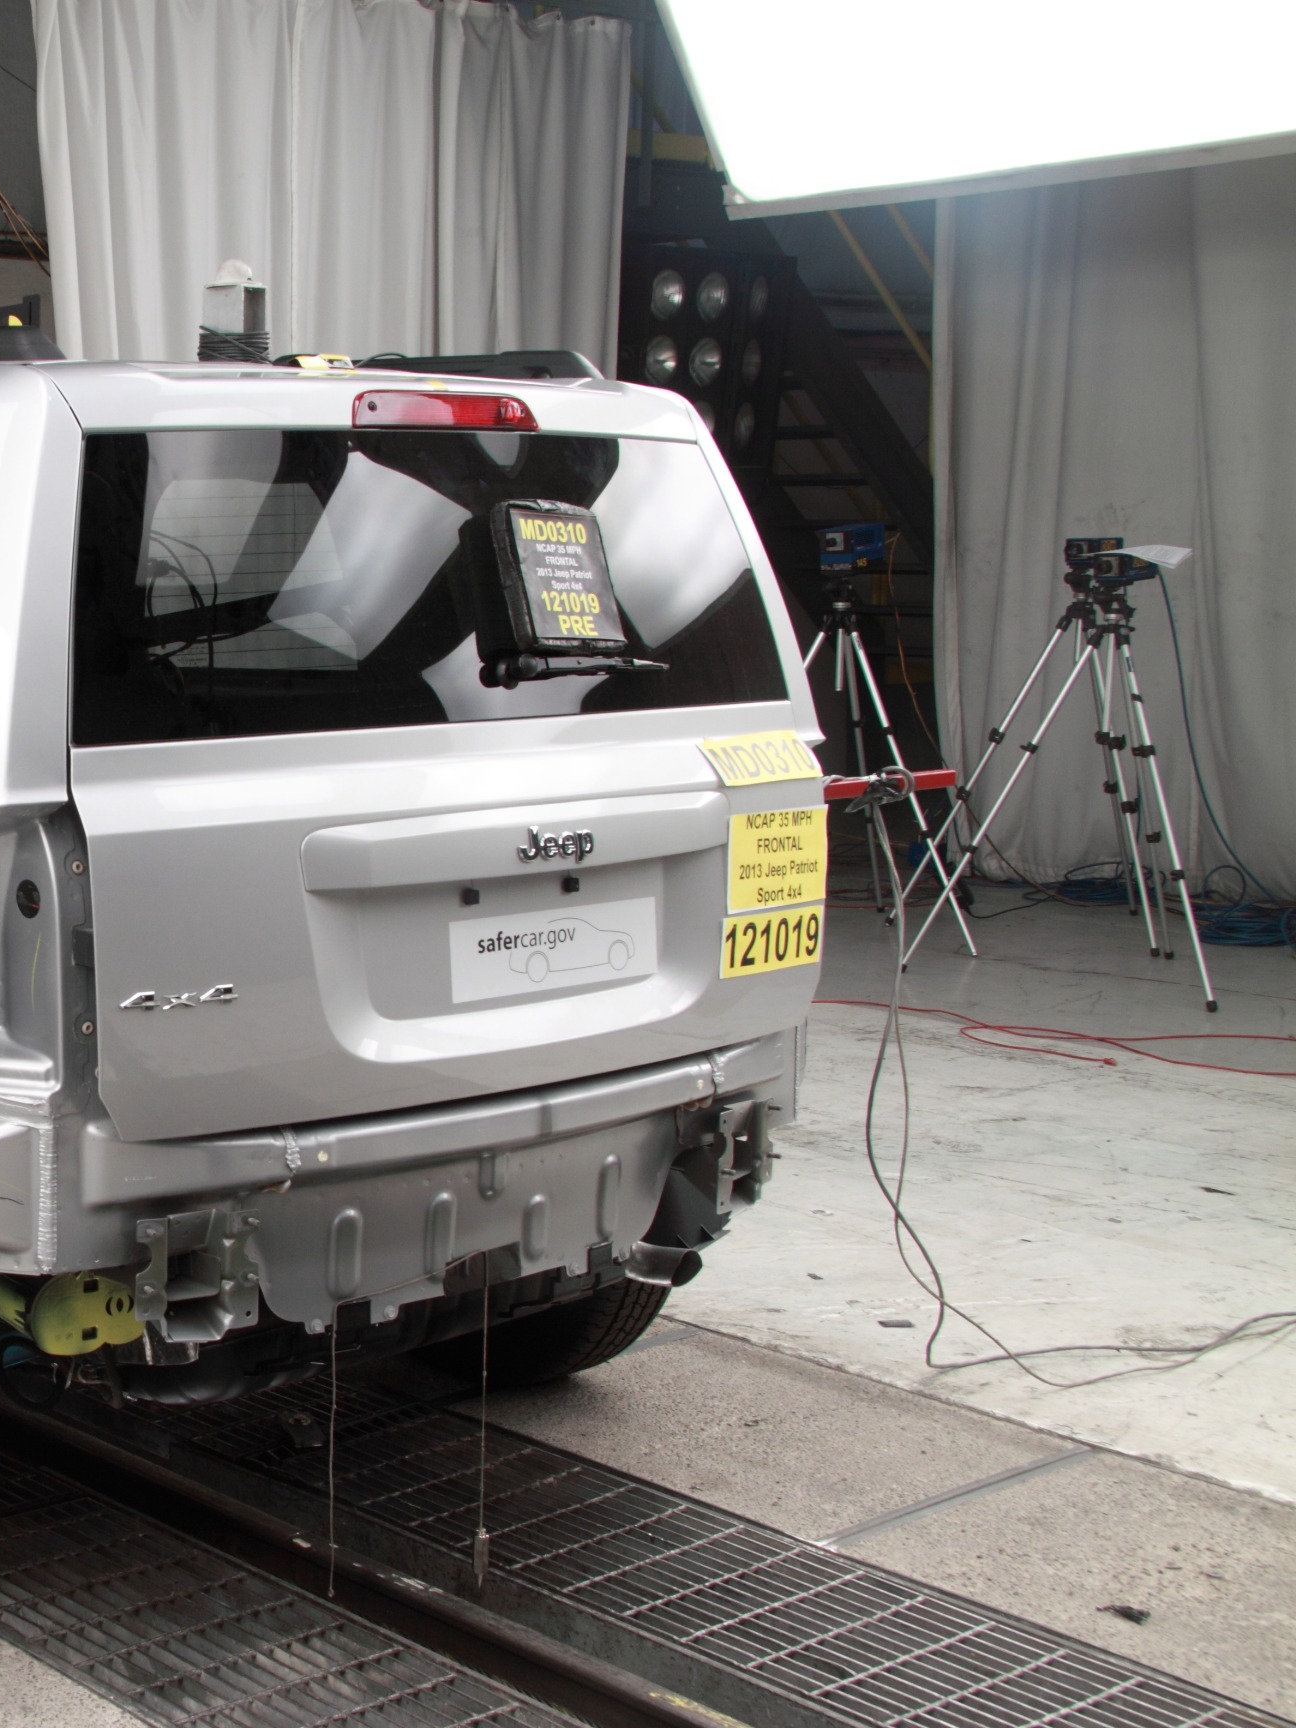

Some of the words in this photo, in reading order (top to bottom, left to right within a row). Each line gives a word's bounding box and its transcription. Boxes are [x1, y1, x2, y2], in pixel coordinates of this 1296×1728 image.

[519, 518, 586, 544] MD0310
[536, 543, 556, 553] NCAP
[557, 544, 565, 554] 35
[566, 545, 582, 555] MPH
[545, 556, 578, 566] FRONTAL
[536, 567, 552, 577] 2013
[554, 569, 569, 579] Jeep
[571, 570, 592, 579] Patriot
[552, 581, 570, 591] Sport
[571, 582, 582, 590] 4x4
[541, 591, 600, 614] 121019
[558, 615, 598, 636] PRE
[708, 738, 816, 782] MD0310
[746, 812, 776, 830] NCAP
[778, 811, 789, 827] 35
[792, 810, 812, 827] MPH
[517, 825, 594, 864] Jeep
[757, 836, 803, 854] FRONTAL
[739, 864, 763, 880] 2013
[765, 862, 787, 880] Jeep
[789, 859, 818, 875] Patriot
[756, 887, 785, 907] Sport
[787, 884, 802, 899] 4x4
[477, 927, 576, 954] safercar.gov
[725, 913, 820, 969] 121019
